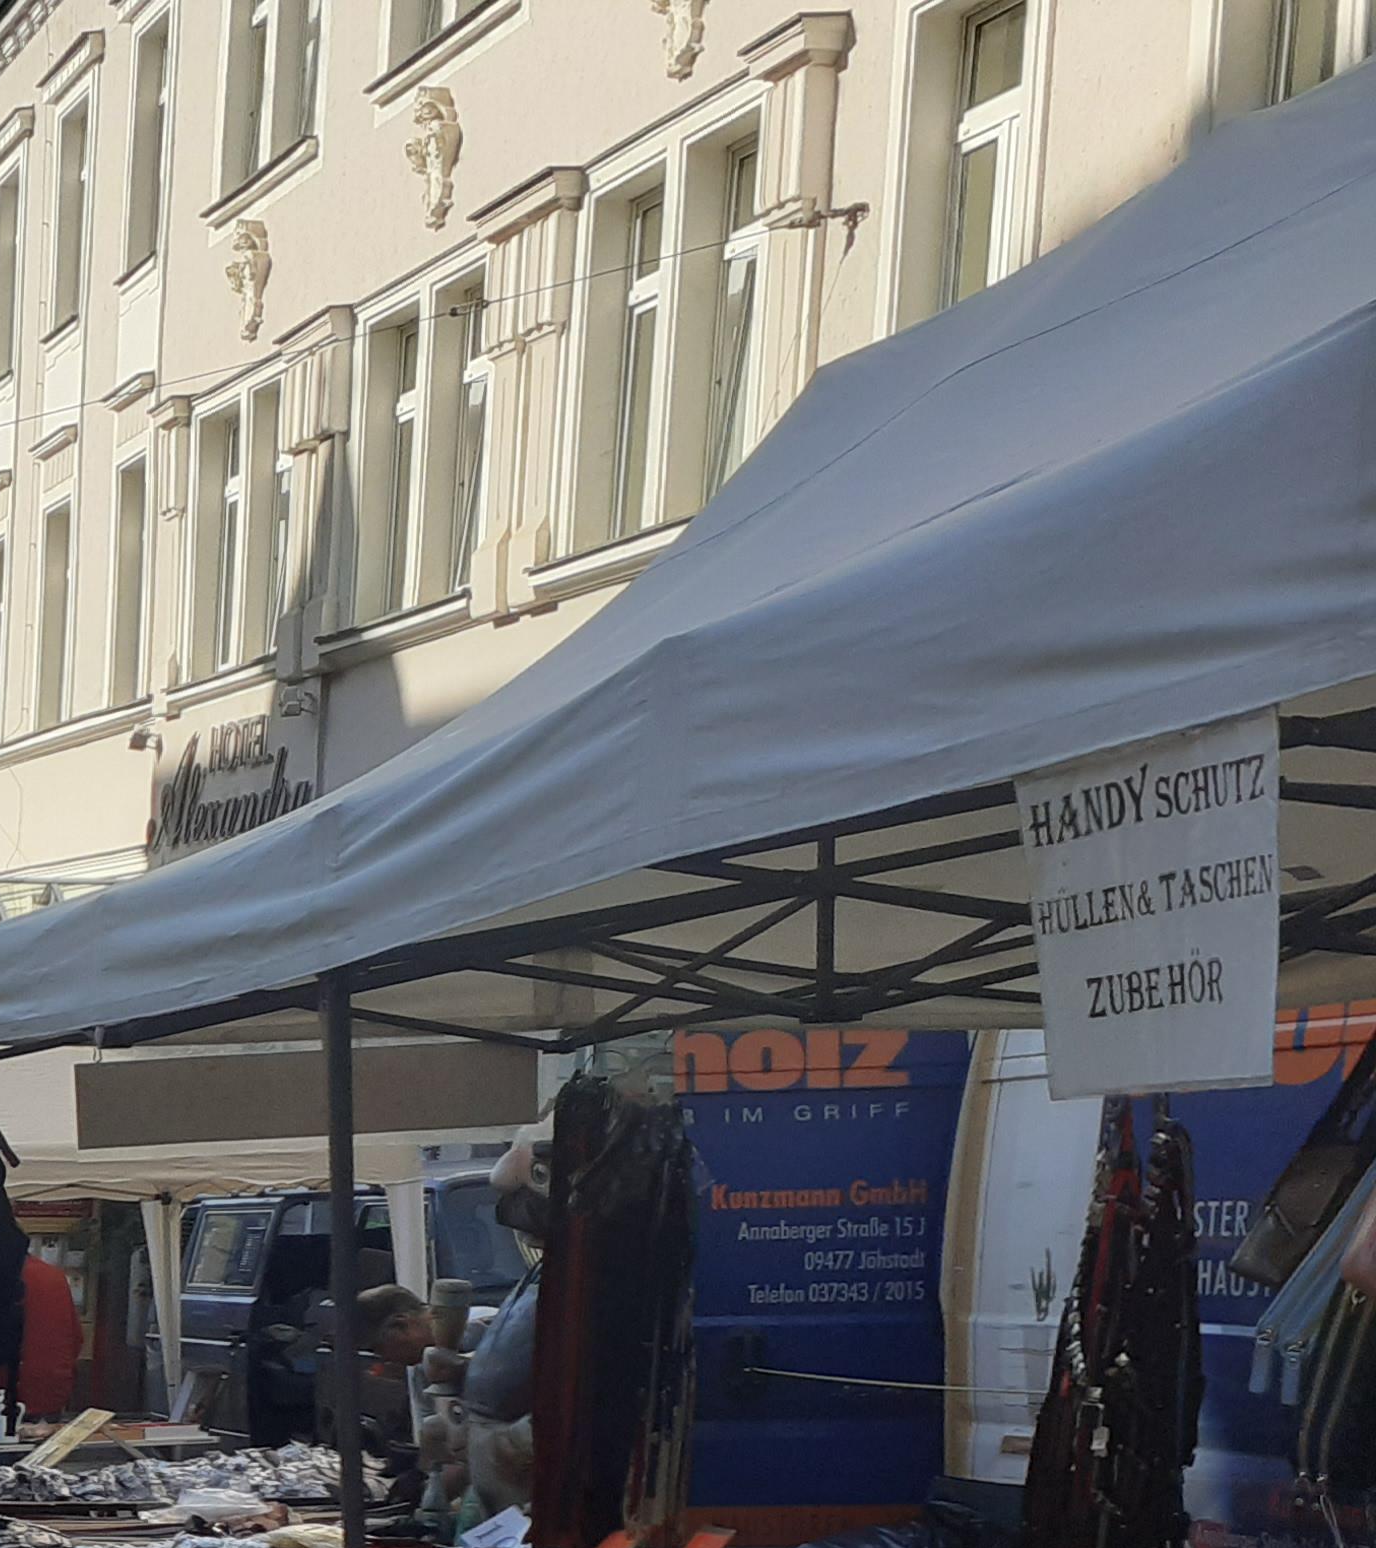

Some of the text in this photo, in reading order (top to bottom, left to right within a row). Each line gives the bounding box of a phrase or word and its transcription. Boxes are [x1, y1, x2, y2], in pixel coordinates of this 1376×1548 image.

[209, 714, 273, 774] HOTEL
[1029, 754, 1265, 848] HANDY SCHUTZ
[1158, 853, 1274, 913] TASCHEN
[1086, 947, 1224, 1020] ZUBEHÖR
[725, 1102, 909, 1123] IM GRIFF
[711, 1180, 927, 1210] Kunzmann GmbH
[737, 1219, 832, 1243] Annaberger
[837, 1217, 889, 1238] Straße
[1193, 1200, 1248, 1238] STER
[804, 1250, 853, 1271] 09477
[748, 1284, 805, 1304] Telefon
[809, 1282, 868, 1302] 037343
[885, 1281, 925, 1300] 2015
